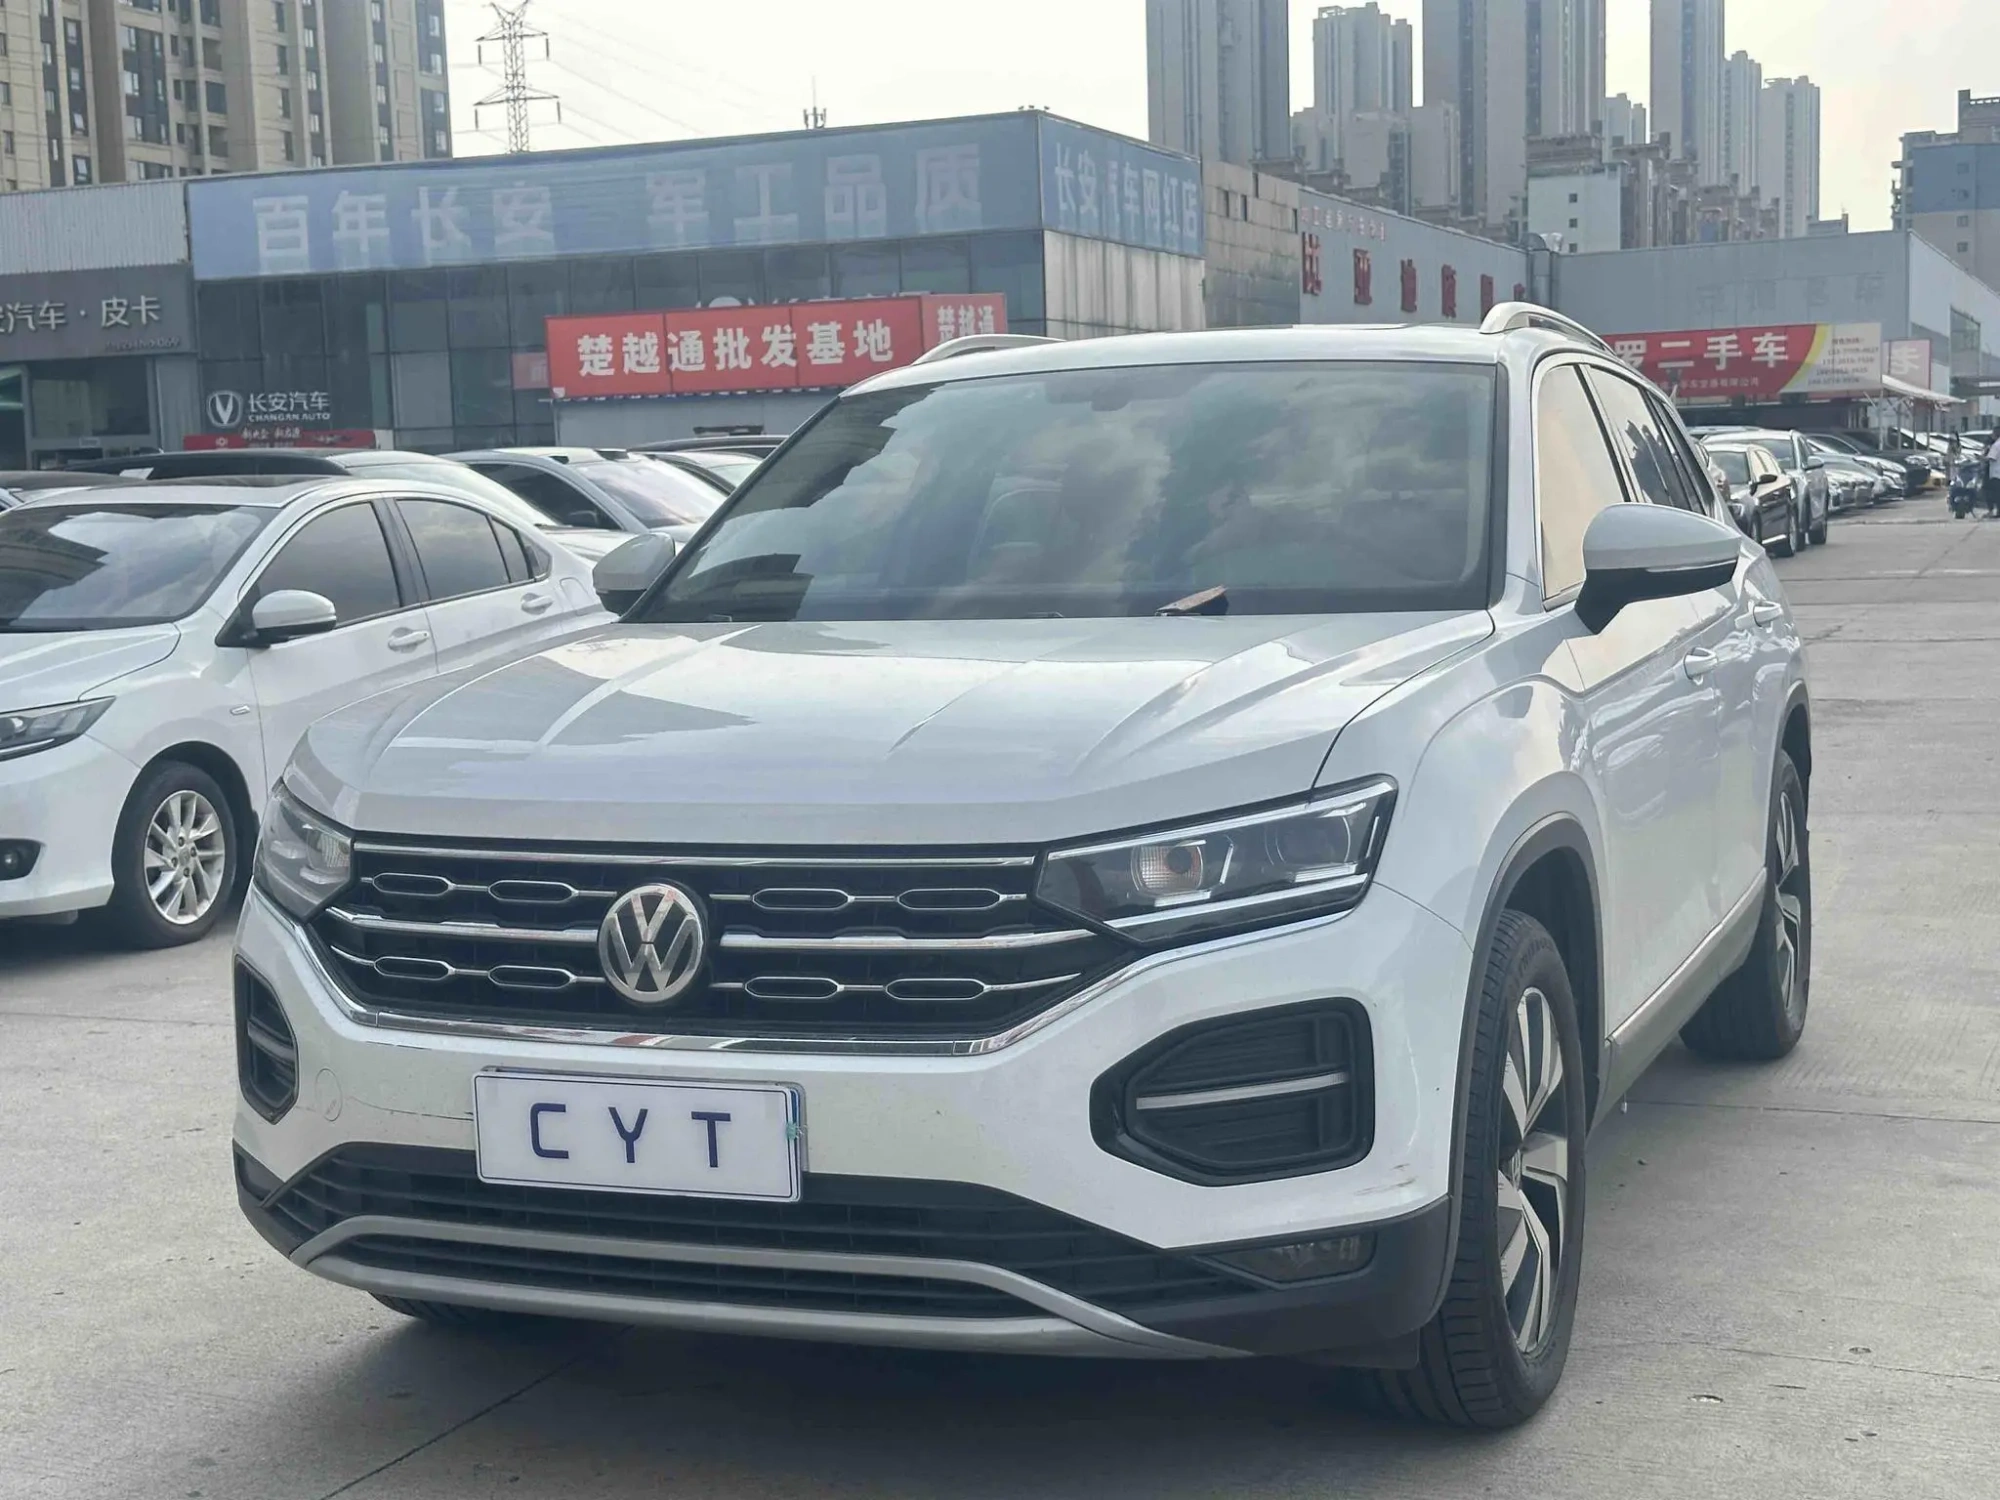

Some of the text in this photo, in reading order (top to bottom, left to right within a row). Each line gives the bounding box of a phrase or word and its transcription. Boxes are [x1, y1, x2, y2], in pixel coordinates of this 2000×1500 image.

[253, 181, 555, 259] 百年长安
[0, 295, 161, 333] 汽车·皮卡
[577, 318, 894, 377] 楚越通批发基地
[248, 412, 331, 423] CHANGAN AUTO
[249, 390, 330, 413] 长安汽车
